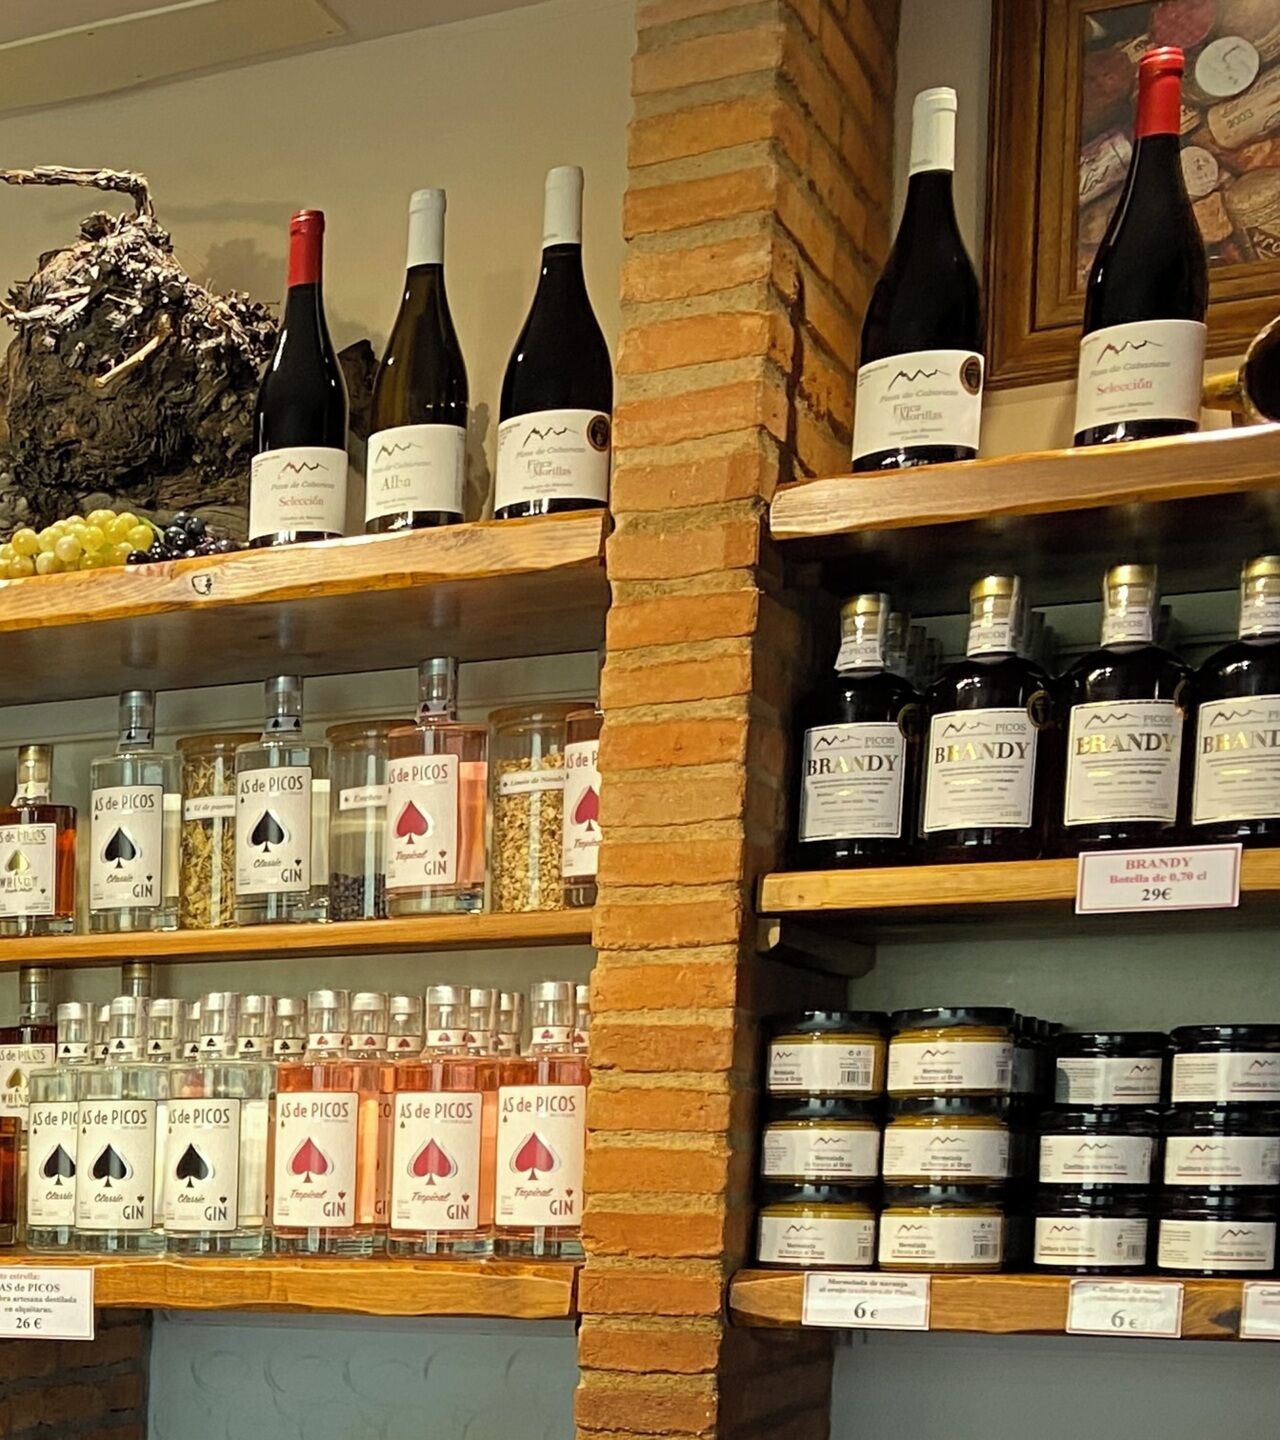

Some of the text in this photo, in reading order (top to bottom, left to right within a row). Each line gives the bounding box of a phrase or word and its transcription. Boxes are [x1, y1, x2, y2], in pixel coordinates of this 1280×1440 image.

[1096, 378, 1153, 396] Selección
[898, 410, 943, 422] Morillas
[380, 474, 411, 491] Alba
[278, 494, 324, 509] Selección
[995, 723, 1027, 732] PICOS
[1076, 732, 1177, 755] BRANDY
[934, 741, 1031, 765] BRANDY
[807, 754, 899, 776] BRANDY
[241, 776, 303, 794] AS de PICOS
[94, 794, 154, 812] AS de PICOS
[424, 861, 447, 875] GIN
[1126, 857, 1192, 870] BRANDY
[281, 868, 302, 884] GIN
[1110, 871, 1207, 884] Botella de 0,70 cl
[132, 884, 153, 898] GIN
[1142, 888, 1172, 901] 29€
[280, 1101, 349, 1118] AS de PICOS
[399, 1101, 473, 1119] AS de PICOS
[503, 1095, 576, 1113] AS de PICOS
[122, 1205, 145, 1220] GIN
[203, 1206, 228, 1221] GIN
[323, 1202, 347, 1217] GIN
[446, 1204, 470, 1221] GIN
[549, 1200, 574, 1216] GIN
[0, 1283, 60, 1292] AS de PICOS
